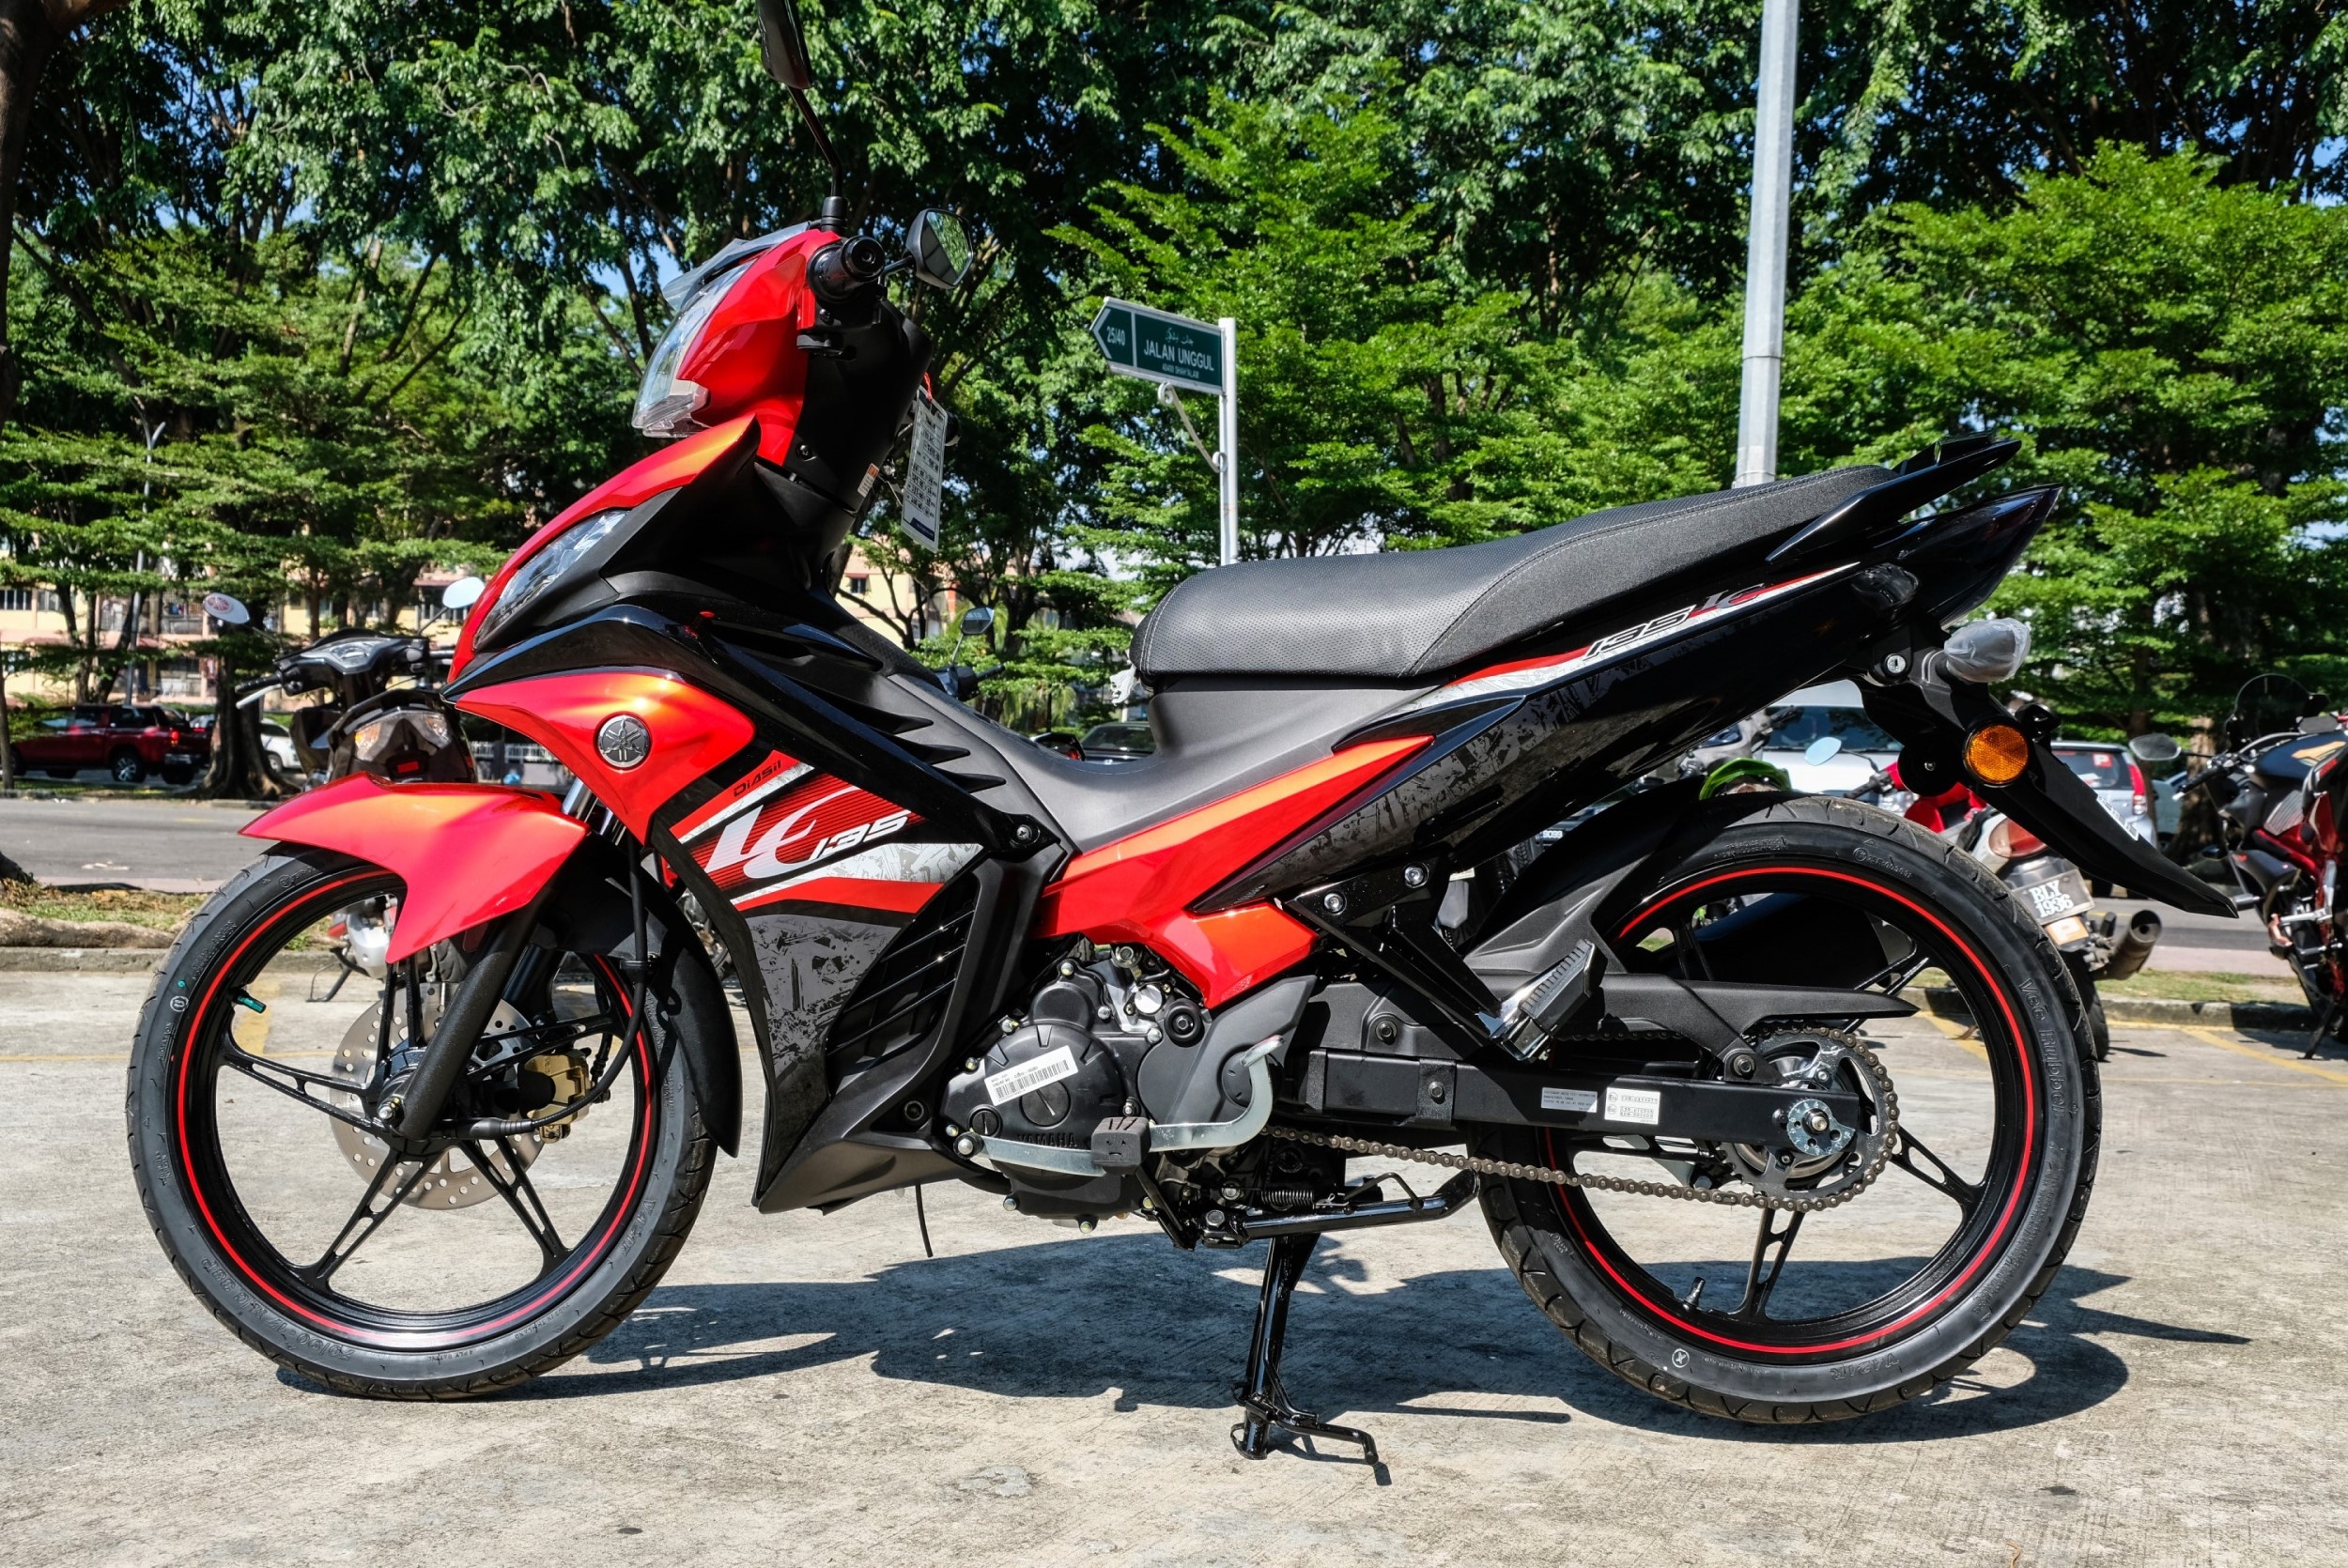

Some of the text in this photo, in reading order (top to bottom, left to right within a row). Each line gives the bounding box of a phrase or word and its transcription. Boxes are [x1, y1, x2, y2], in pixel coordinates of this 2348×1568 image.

[1106, 326, 1126, 346] 25/40
[1144, 339, 1215, 372] JALAN UNGGUL
[1582, 604, 1696, 661] 135
[808, 808, 912, 861] 135
[2029, 880, 2062, 904] BLY
[2036, 894, 2074, 918] 1936
